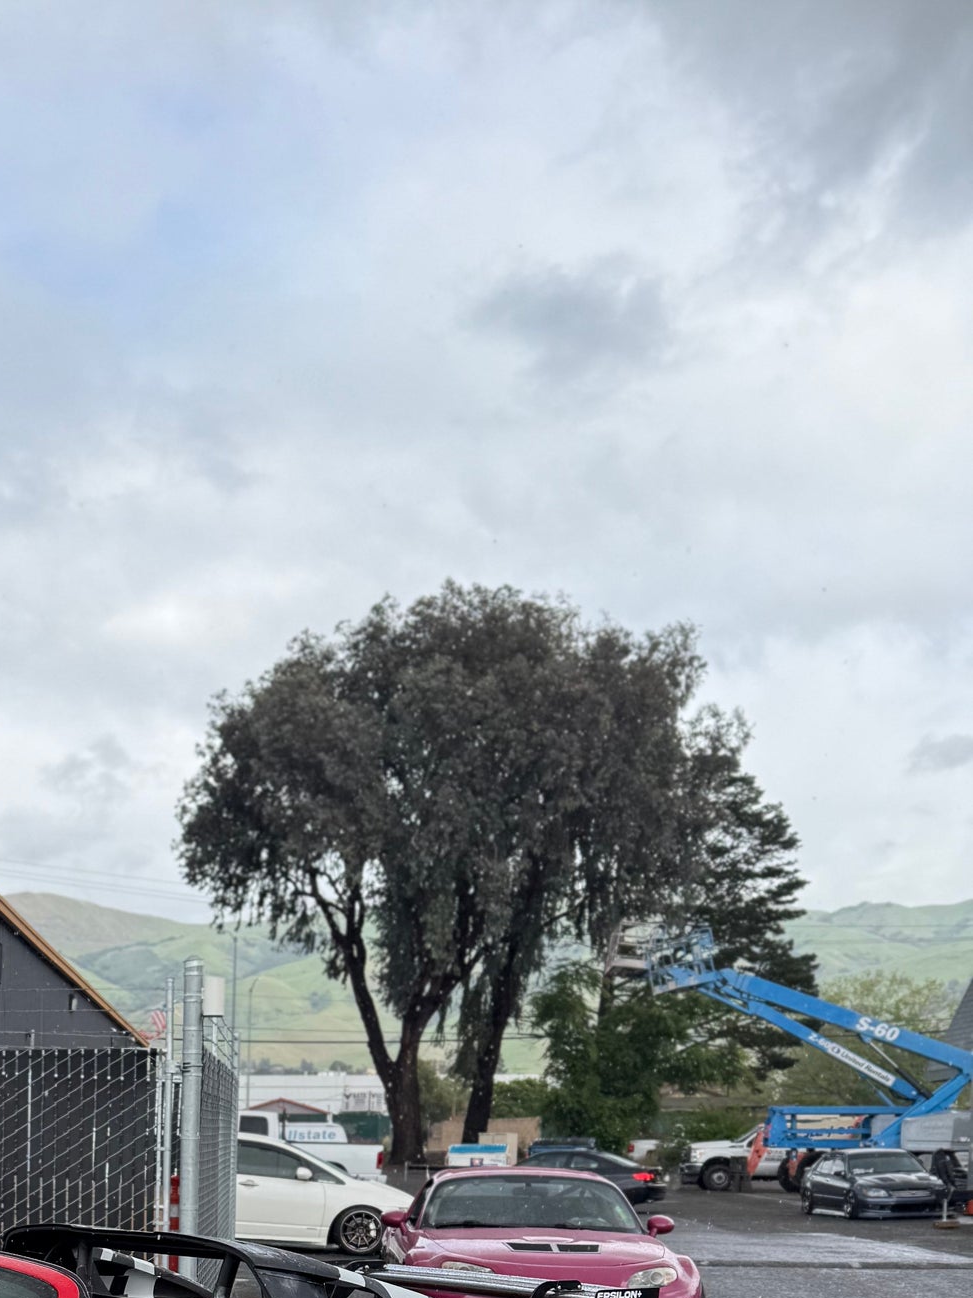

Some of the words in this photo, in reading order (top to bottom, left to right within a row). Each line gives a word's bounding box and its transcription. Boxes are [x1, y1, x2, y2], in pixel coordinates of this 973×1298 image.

[855, 1016, 900, 1041] S-60
[841, 1050, 864, 1068] United
[865, 1064, 892, 1083] Rentals
[288, 1130, 337, 1140] llstate
